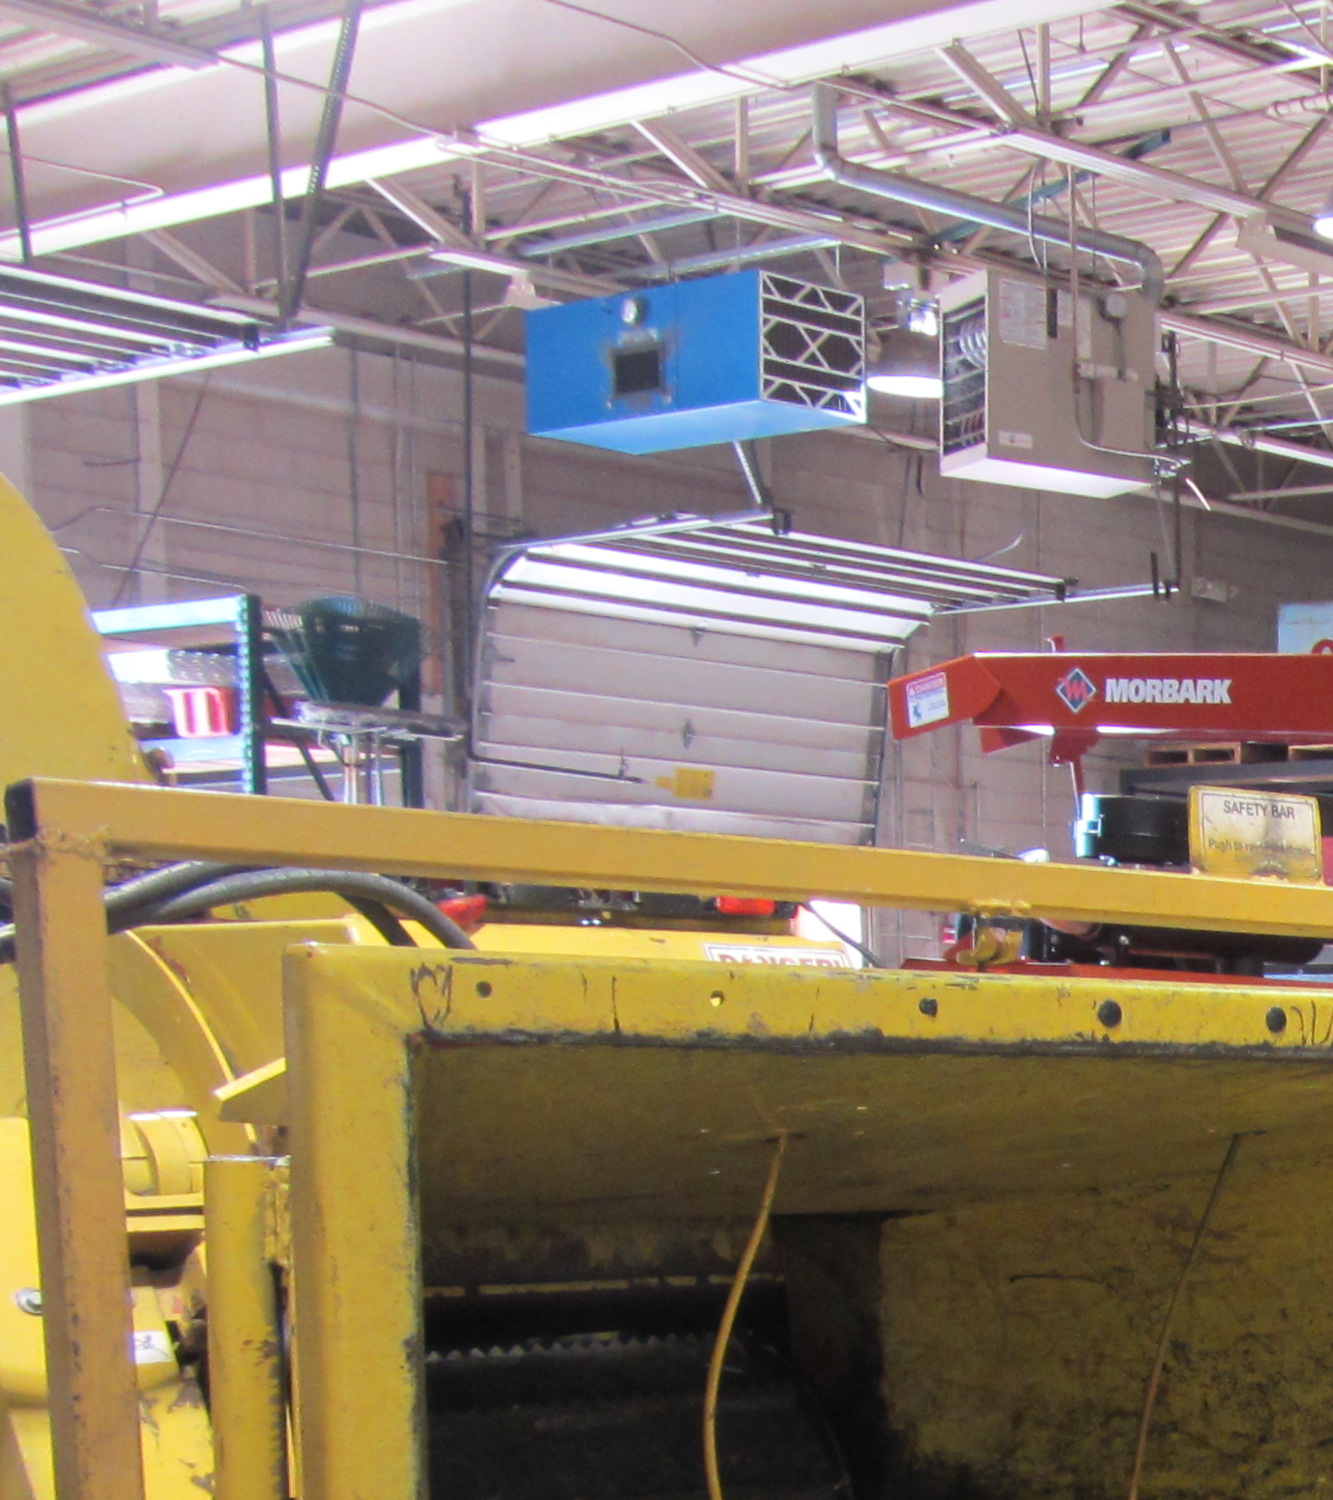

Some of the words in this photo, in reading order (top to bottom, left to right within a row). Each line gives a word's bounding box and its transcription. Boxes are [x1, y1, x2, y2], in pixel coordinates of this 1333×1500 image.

[1105, 678, 1232, 703] MORBARK
[1224, 800, 1267, 818] SAFETY
[1271, 804, 1295, 819] BAR
